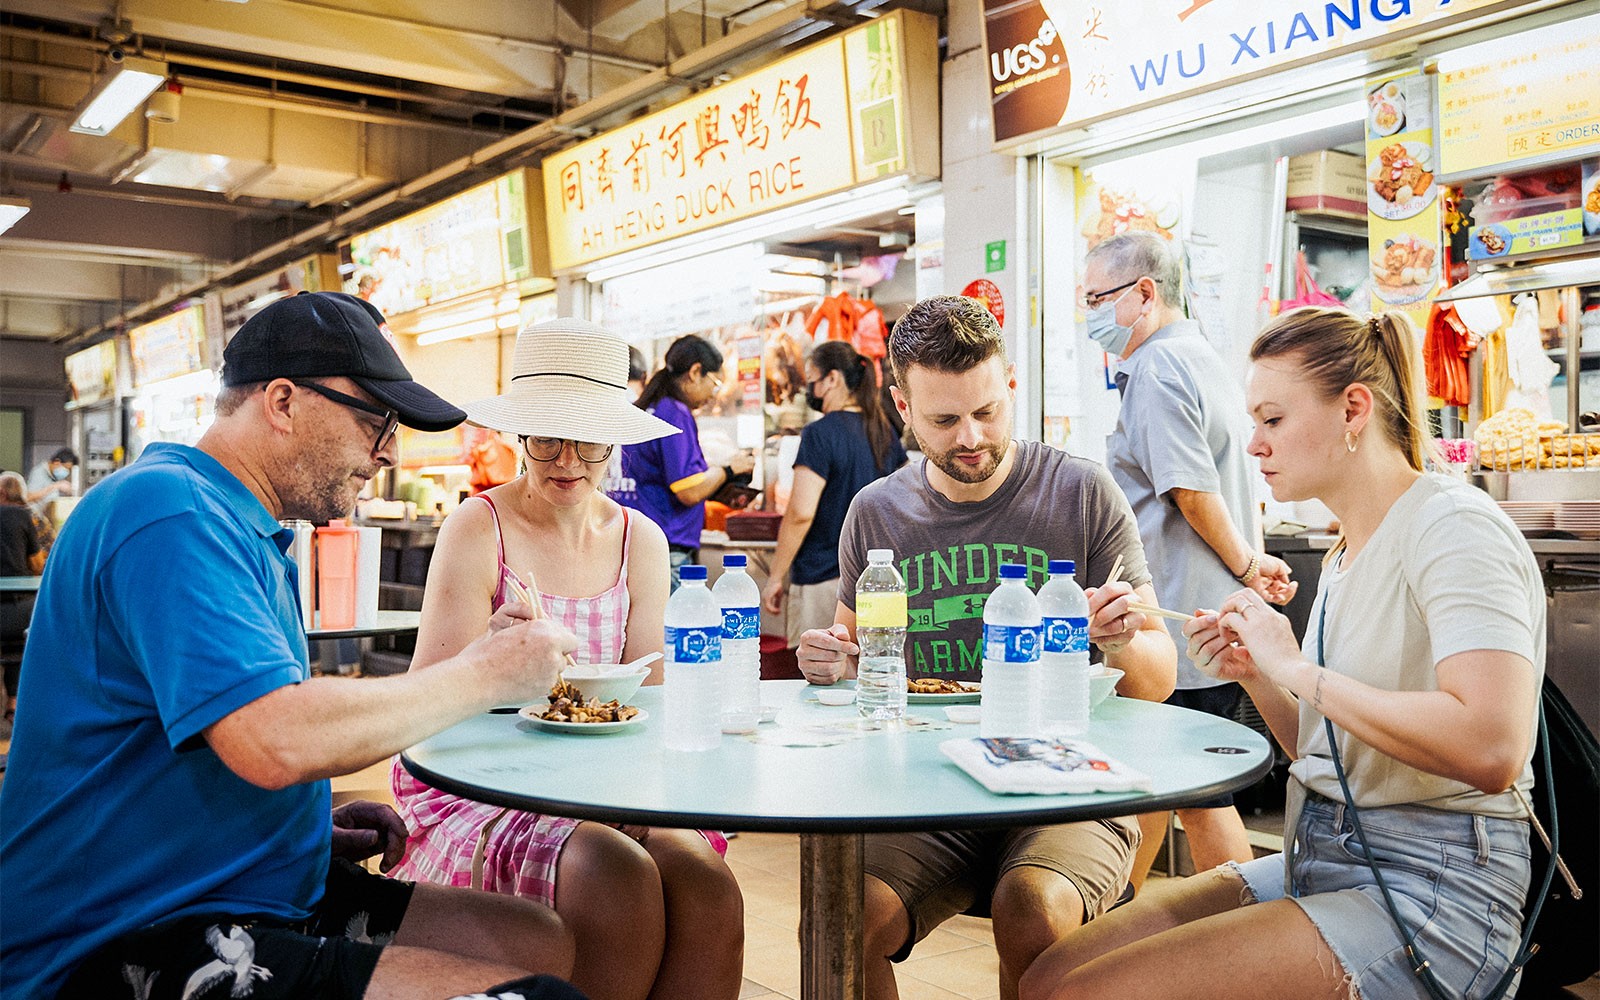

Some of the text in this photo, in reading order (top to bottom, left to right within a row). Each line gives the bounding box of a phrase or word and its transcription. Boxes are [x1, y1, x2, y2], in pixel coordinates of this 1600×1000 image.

[1129, 43, 1206, 91] WU
[1229, 0, 1411, 65] XIANG
[1556, 122, 1600, 143] ORDER
[581, 156, 805, 252] AH HENG DUCK RICE
[899, 543, 1050, 598] UNDER
[918, 615, 930, 625] 19
